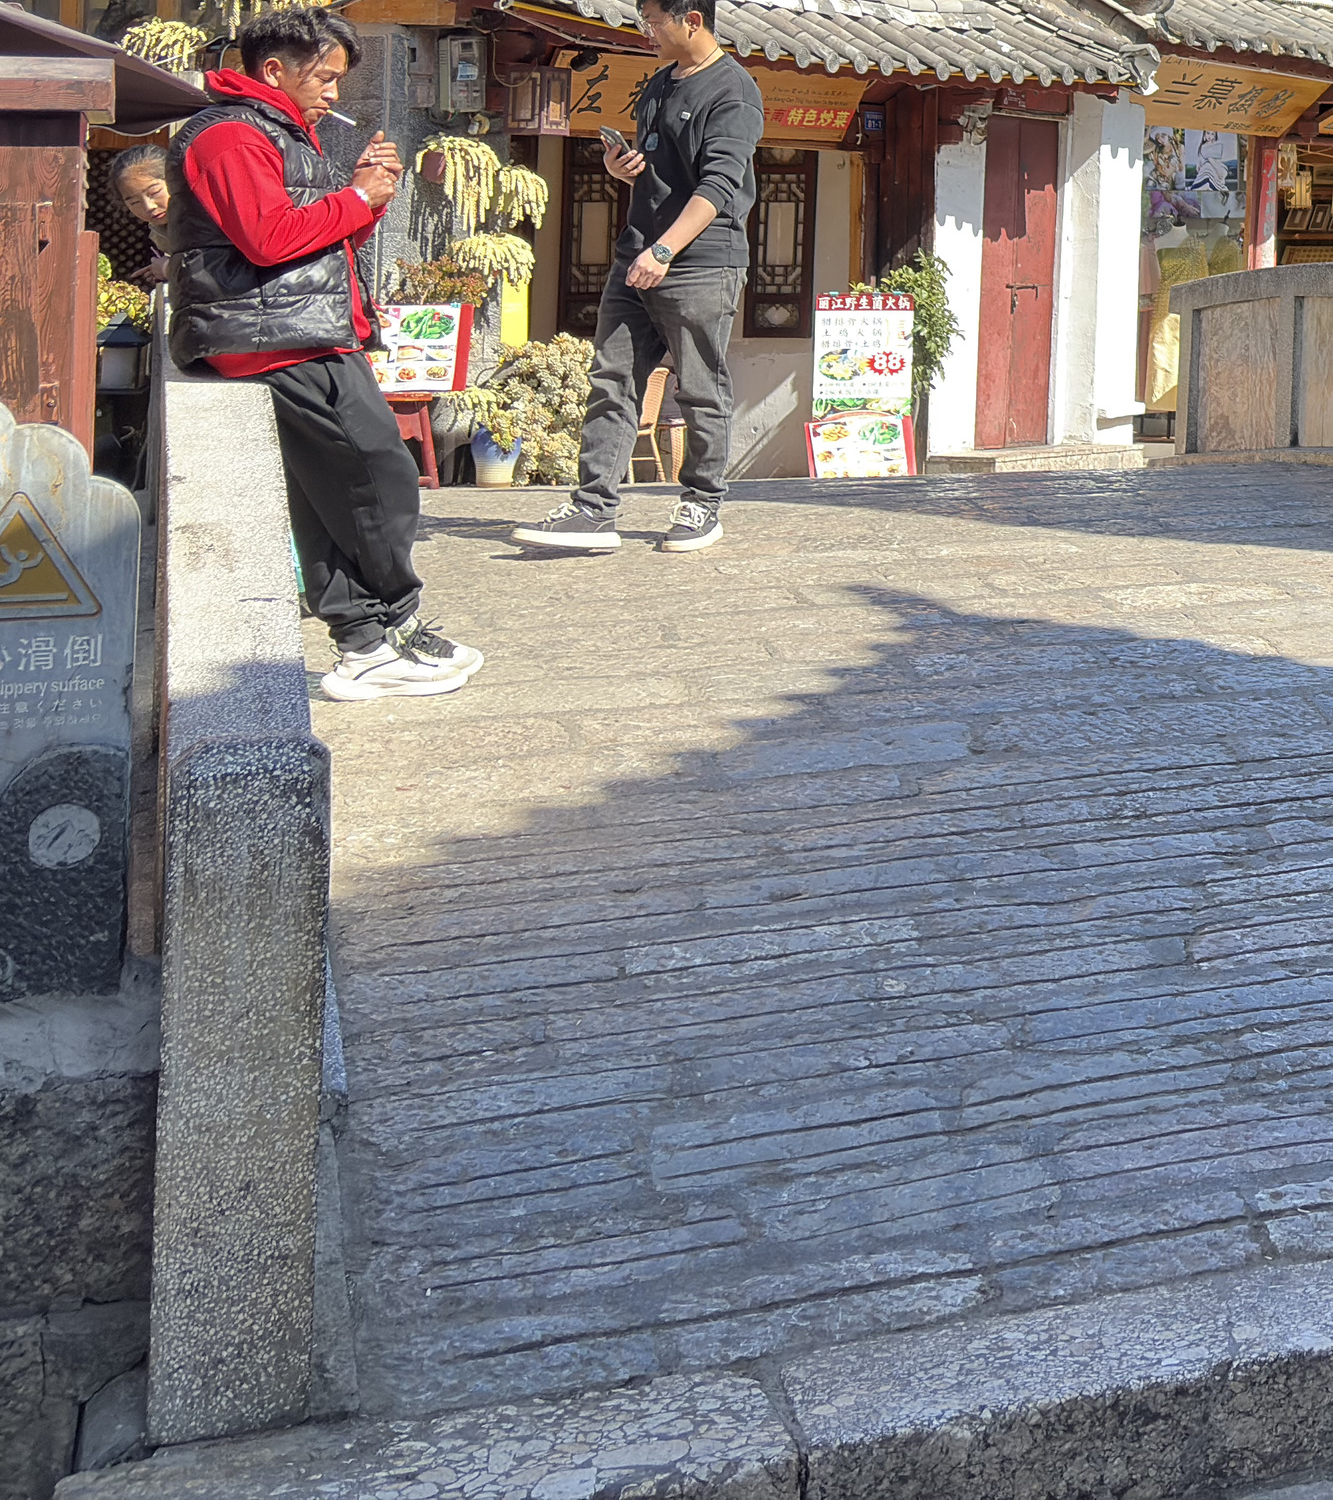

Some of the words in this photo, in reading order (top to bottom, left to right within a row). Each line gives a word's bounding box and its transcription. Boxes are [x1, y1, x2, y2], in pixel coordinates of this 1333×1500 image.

[1152, 72, 1296, 119] 兰慕摄影
[818, 296, 911, 310] 丽江野生菌火锅
[873, 354, 901, 370] 88
[0, 633, 104, 671] 滑倒
[51, 675, 105, 692] surface
